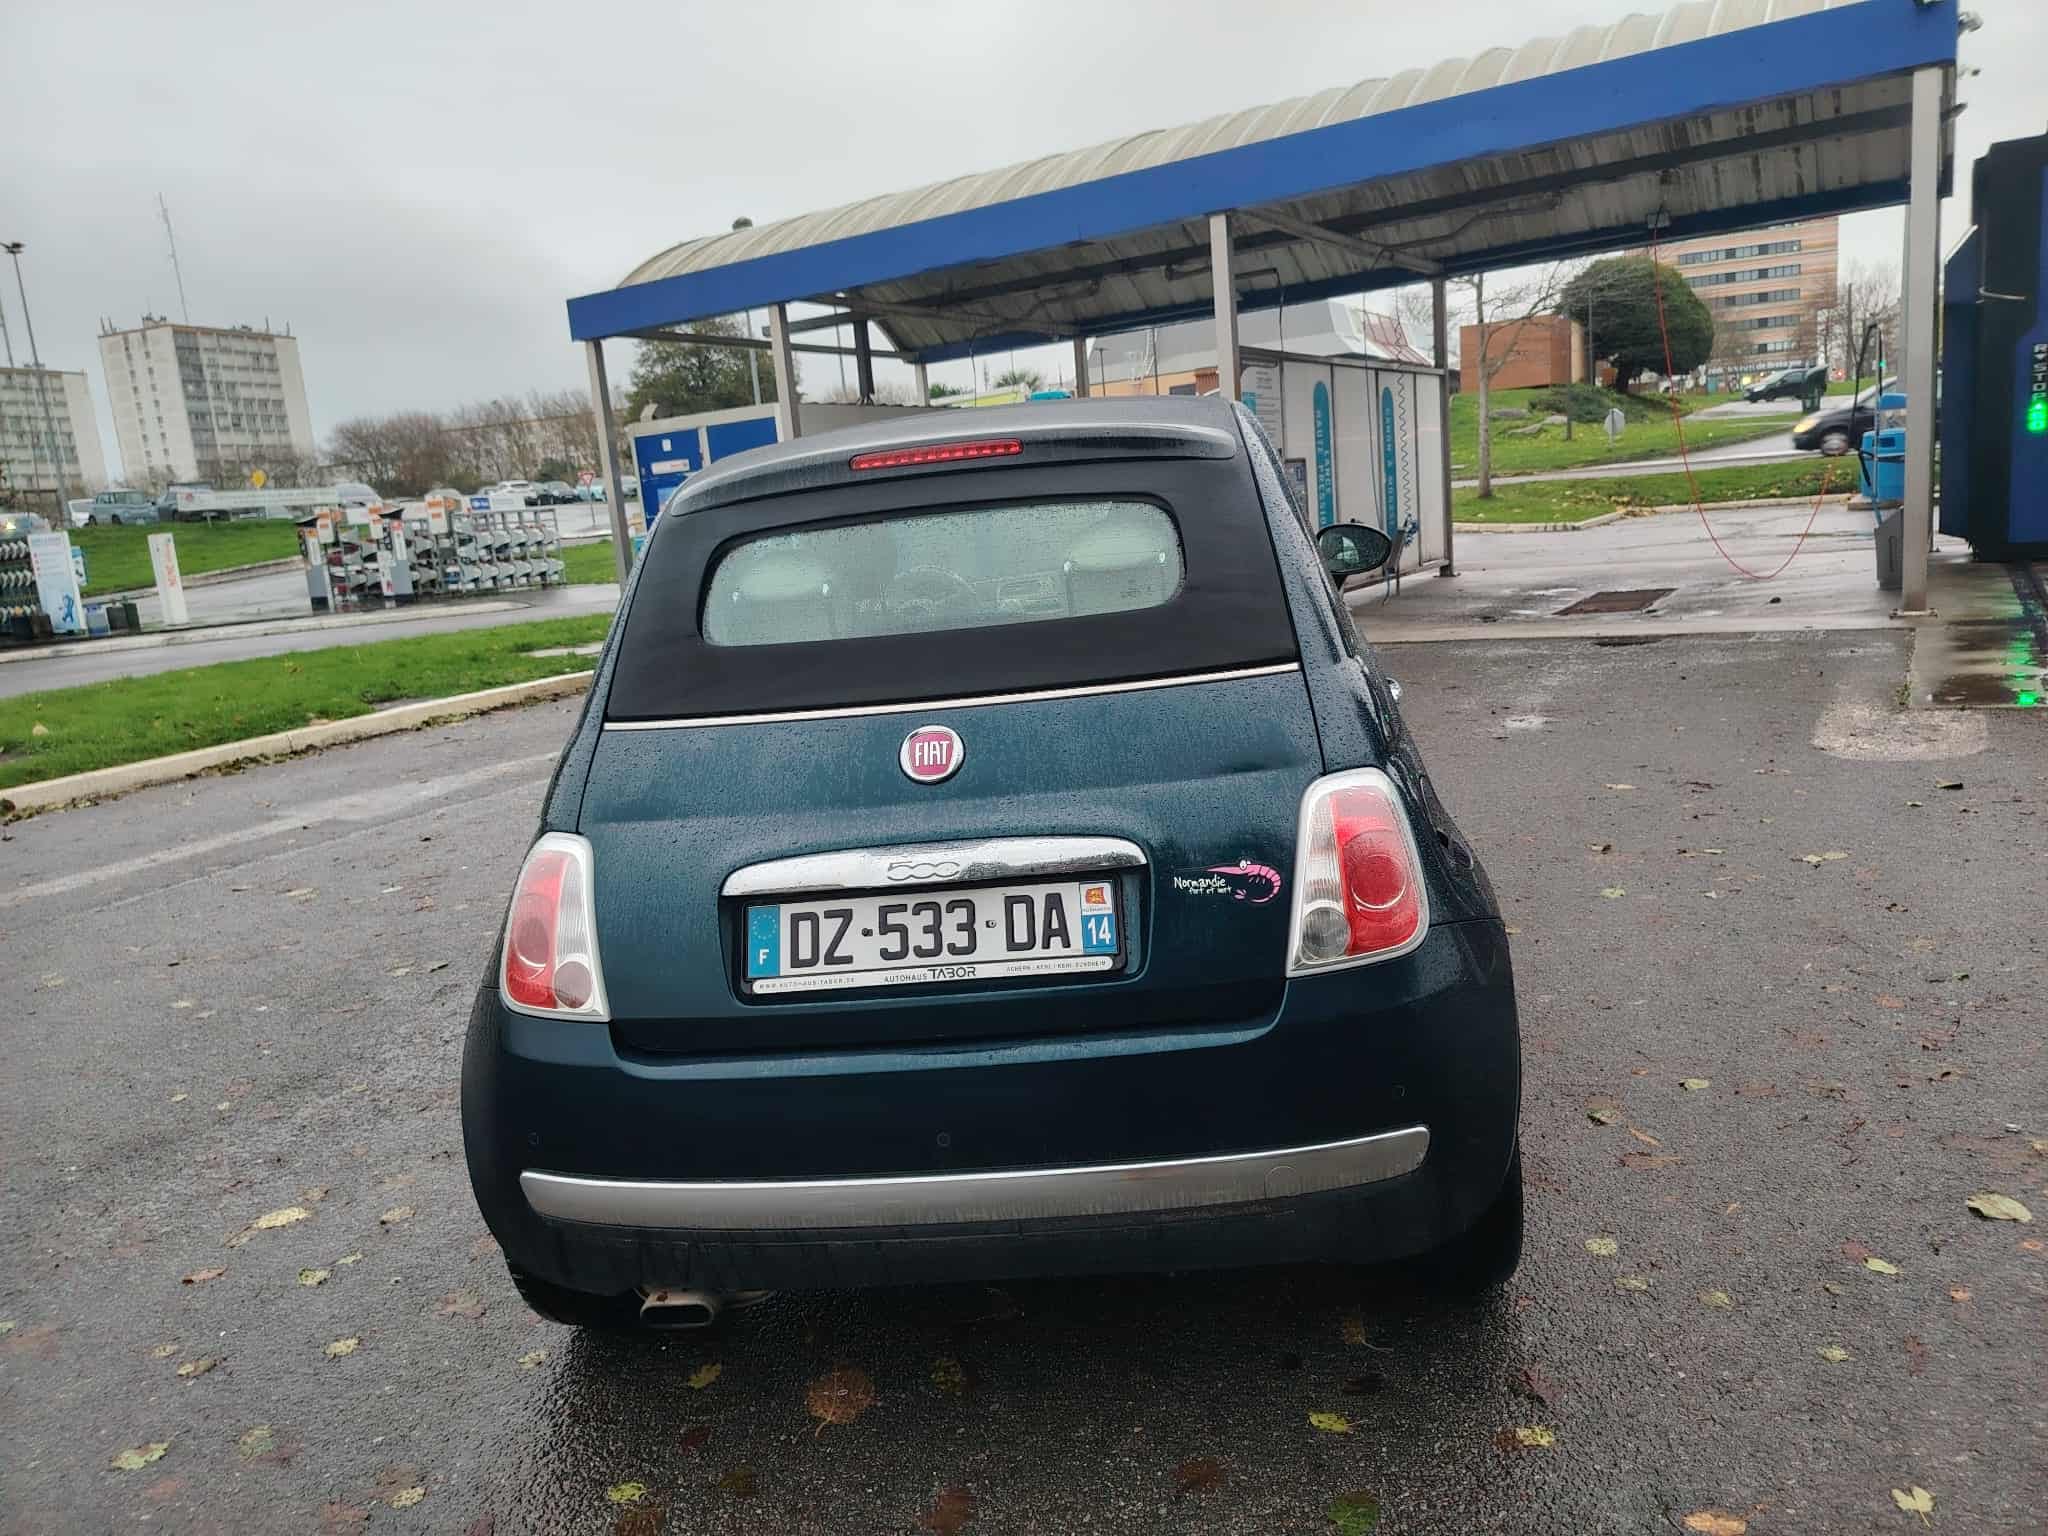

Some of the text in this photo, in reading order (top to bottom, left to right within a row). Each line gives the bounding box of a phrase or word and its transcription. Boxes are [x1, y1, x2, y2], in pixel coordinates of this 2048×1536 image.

[915, 741, 950, 767] FIAT
[888, 861, 960, 881] 500
[1173, 873, 1226, 889] Normandie
[1088, 917, 1111, 945] 14
[759, 949, 770, 965] F
[884, 966, 977, 983] AUTOHAUS TABOR
